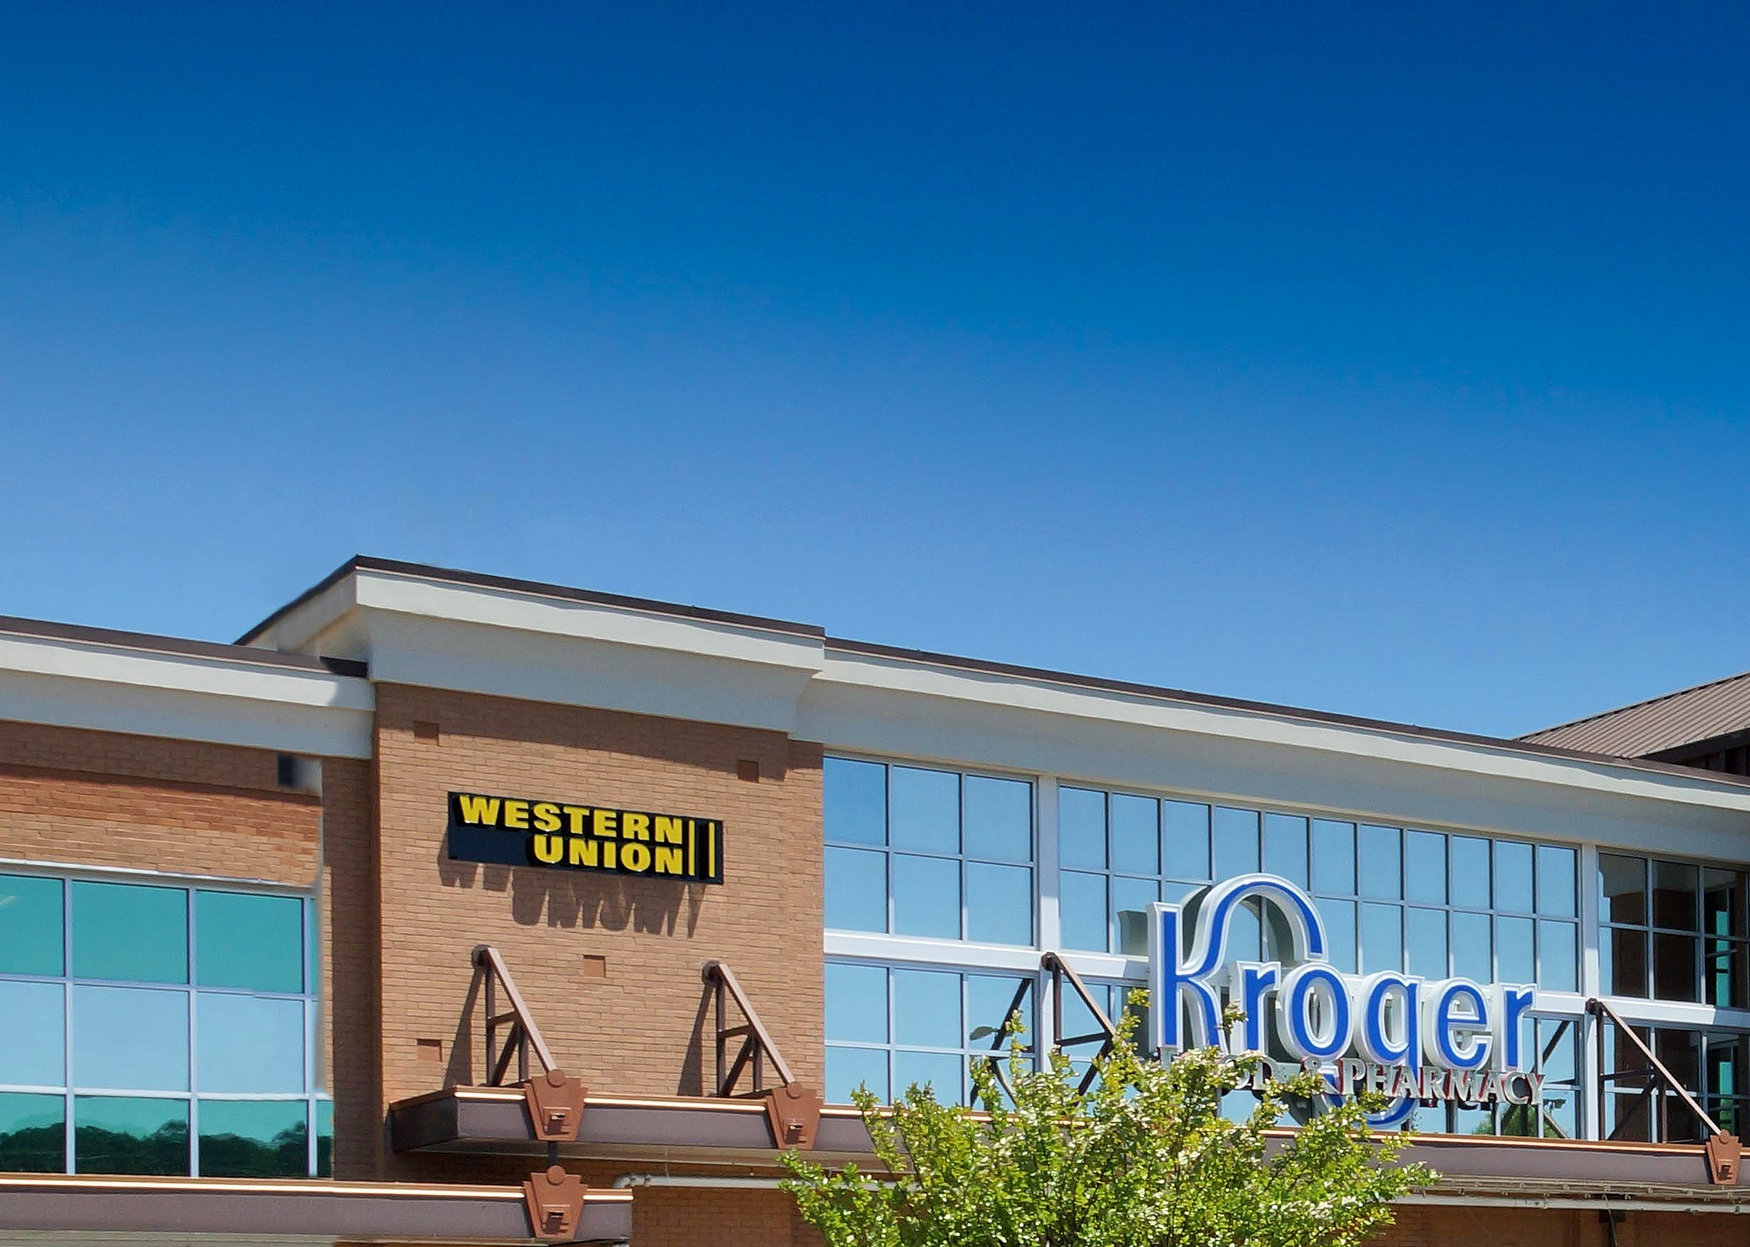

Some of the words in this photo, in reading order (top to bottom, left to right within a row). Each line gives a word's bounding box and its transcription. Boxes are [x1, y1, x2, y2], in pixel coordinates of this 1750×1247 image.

[459, 795, 683, 845] WESTERN
[534, 833, 683, 875] UNION
[1147, 873, 1537, 1127] Kroger
[1341, 1057, 1546, 1105] PHARMACY
